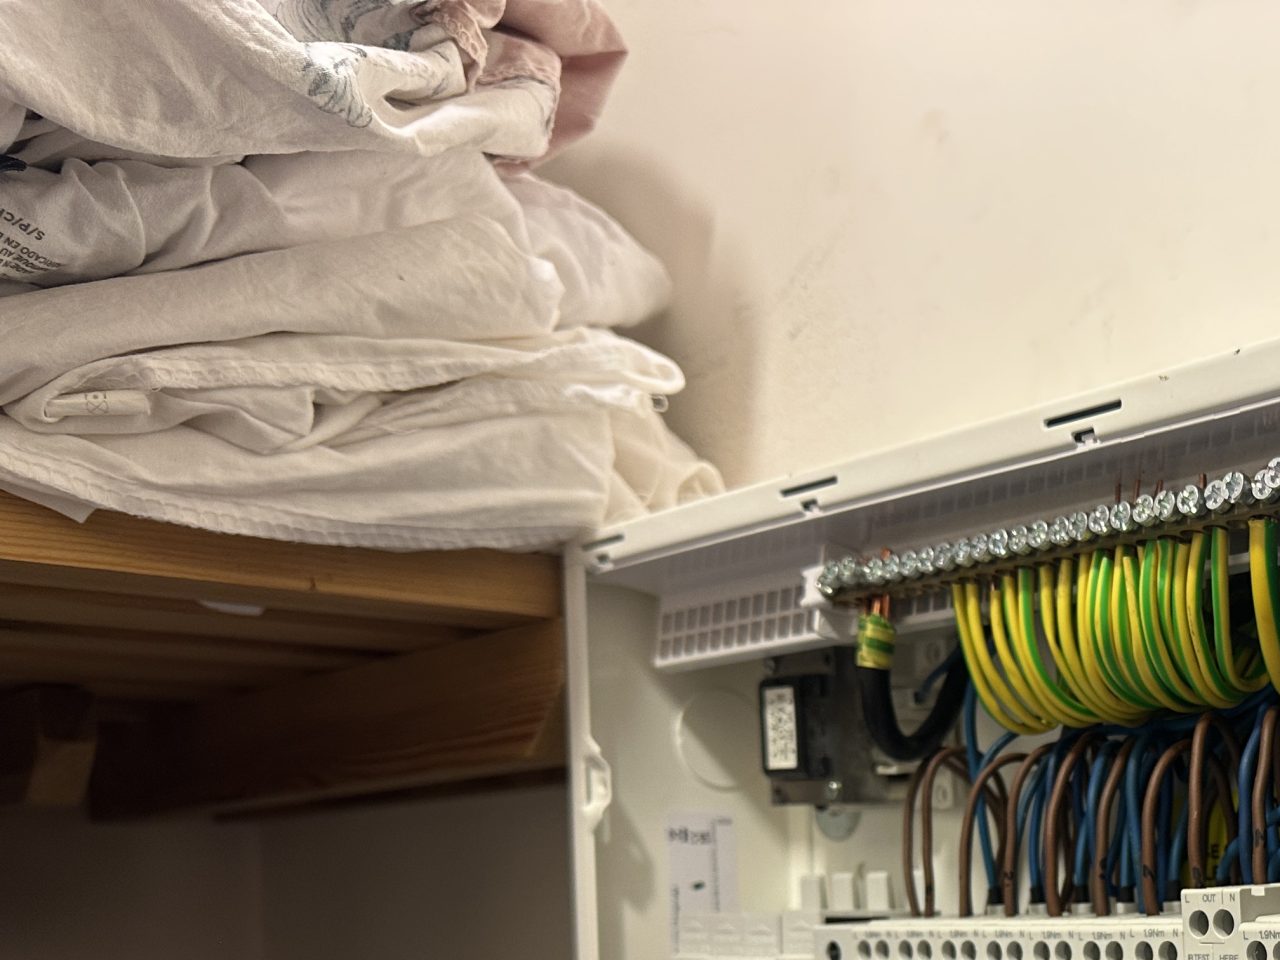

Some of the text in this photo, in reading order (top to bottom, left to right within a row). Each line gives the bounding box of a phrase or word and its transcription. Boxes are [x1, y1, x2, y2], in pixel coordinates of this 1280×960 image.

[1202, 893, 1216, 903] OUT
[1229, 892, 1236, 902] N
[1173, 928, 1178, 937] N
